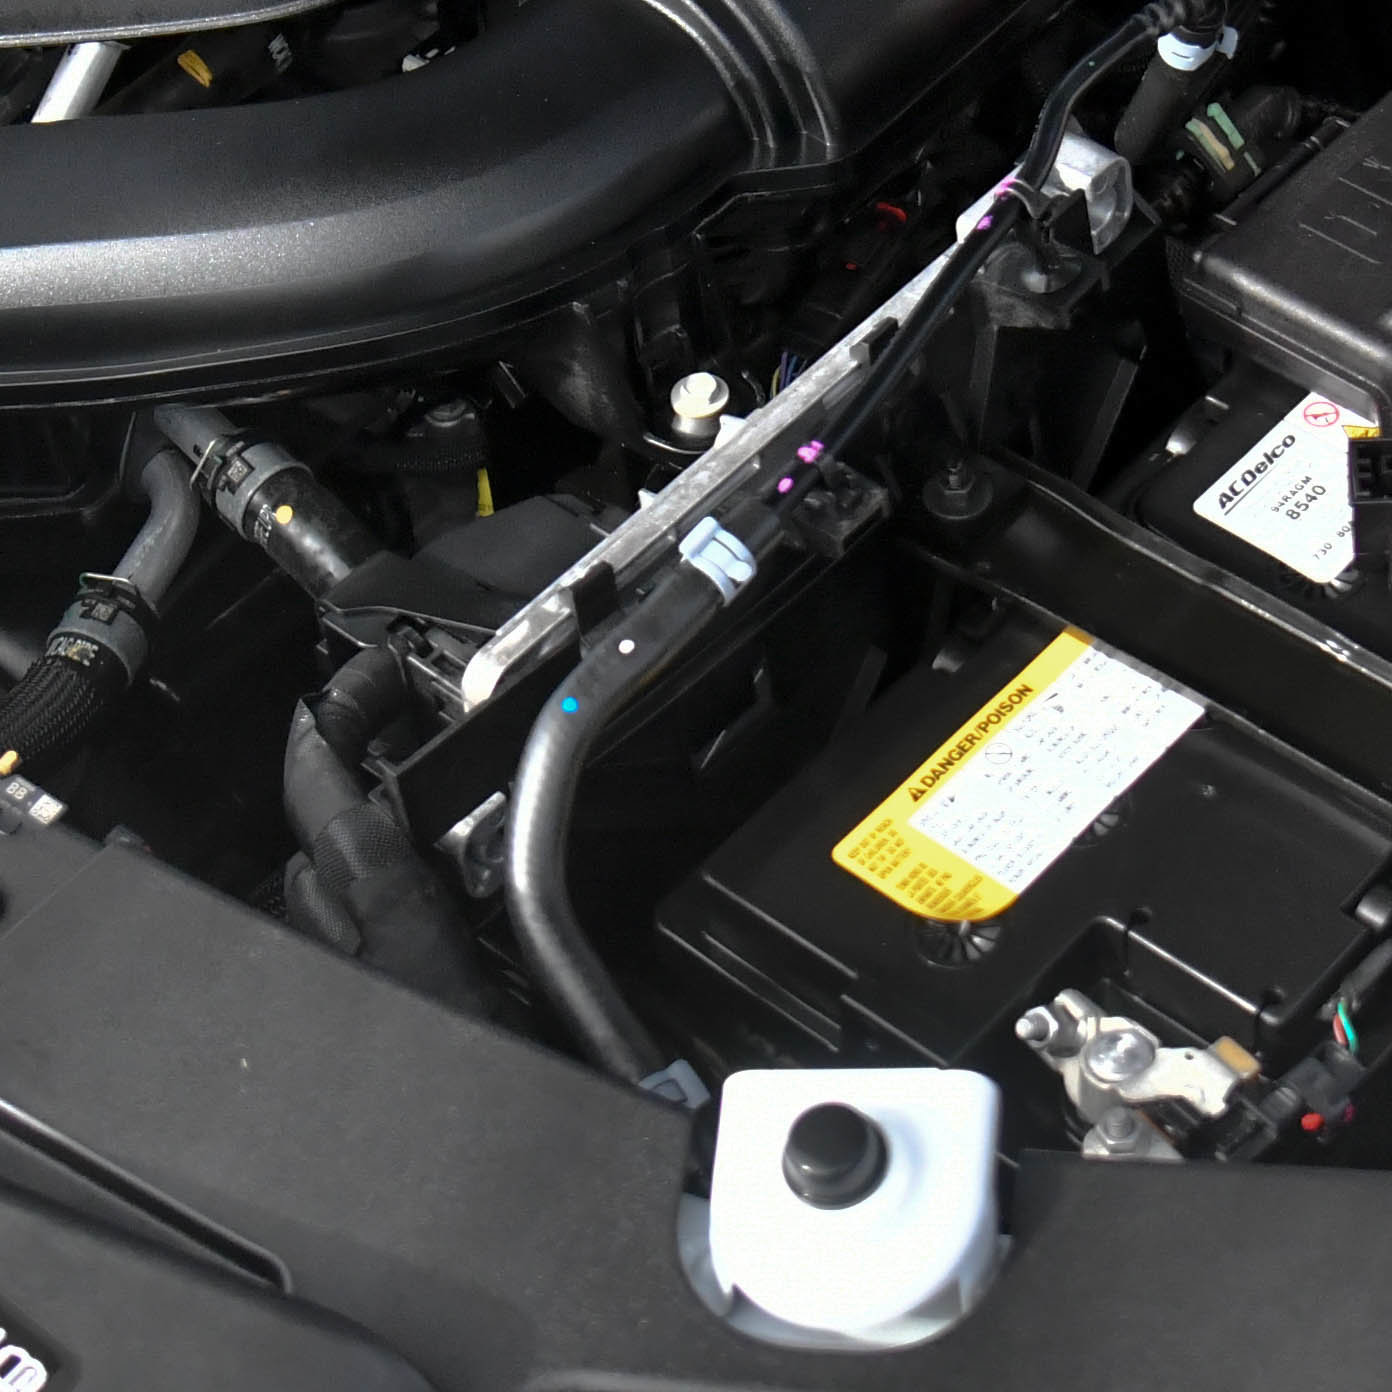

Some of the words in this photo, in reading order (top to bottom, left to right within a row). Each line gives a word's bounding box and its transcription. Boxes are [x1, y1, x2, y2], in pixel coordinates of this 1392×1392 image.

[1218, 434, 1296, 510] ACDelco
[1285, 484, 1327, 520] 8540
[920, 684, 1034, 789] DANGER/POISON
